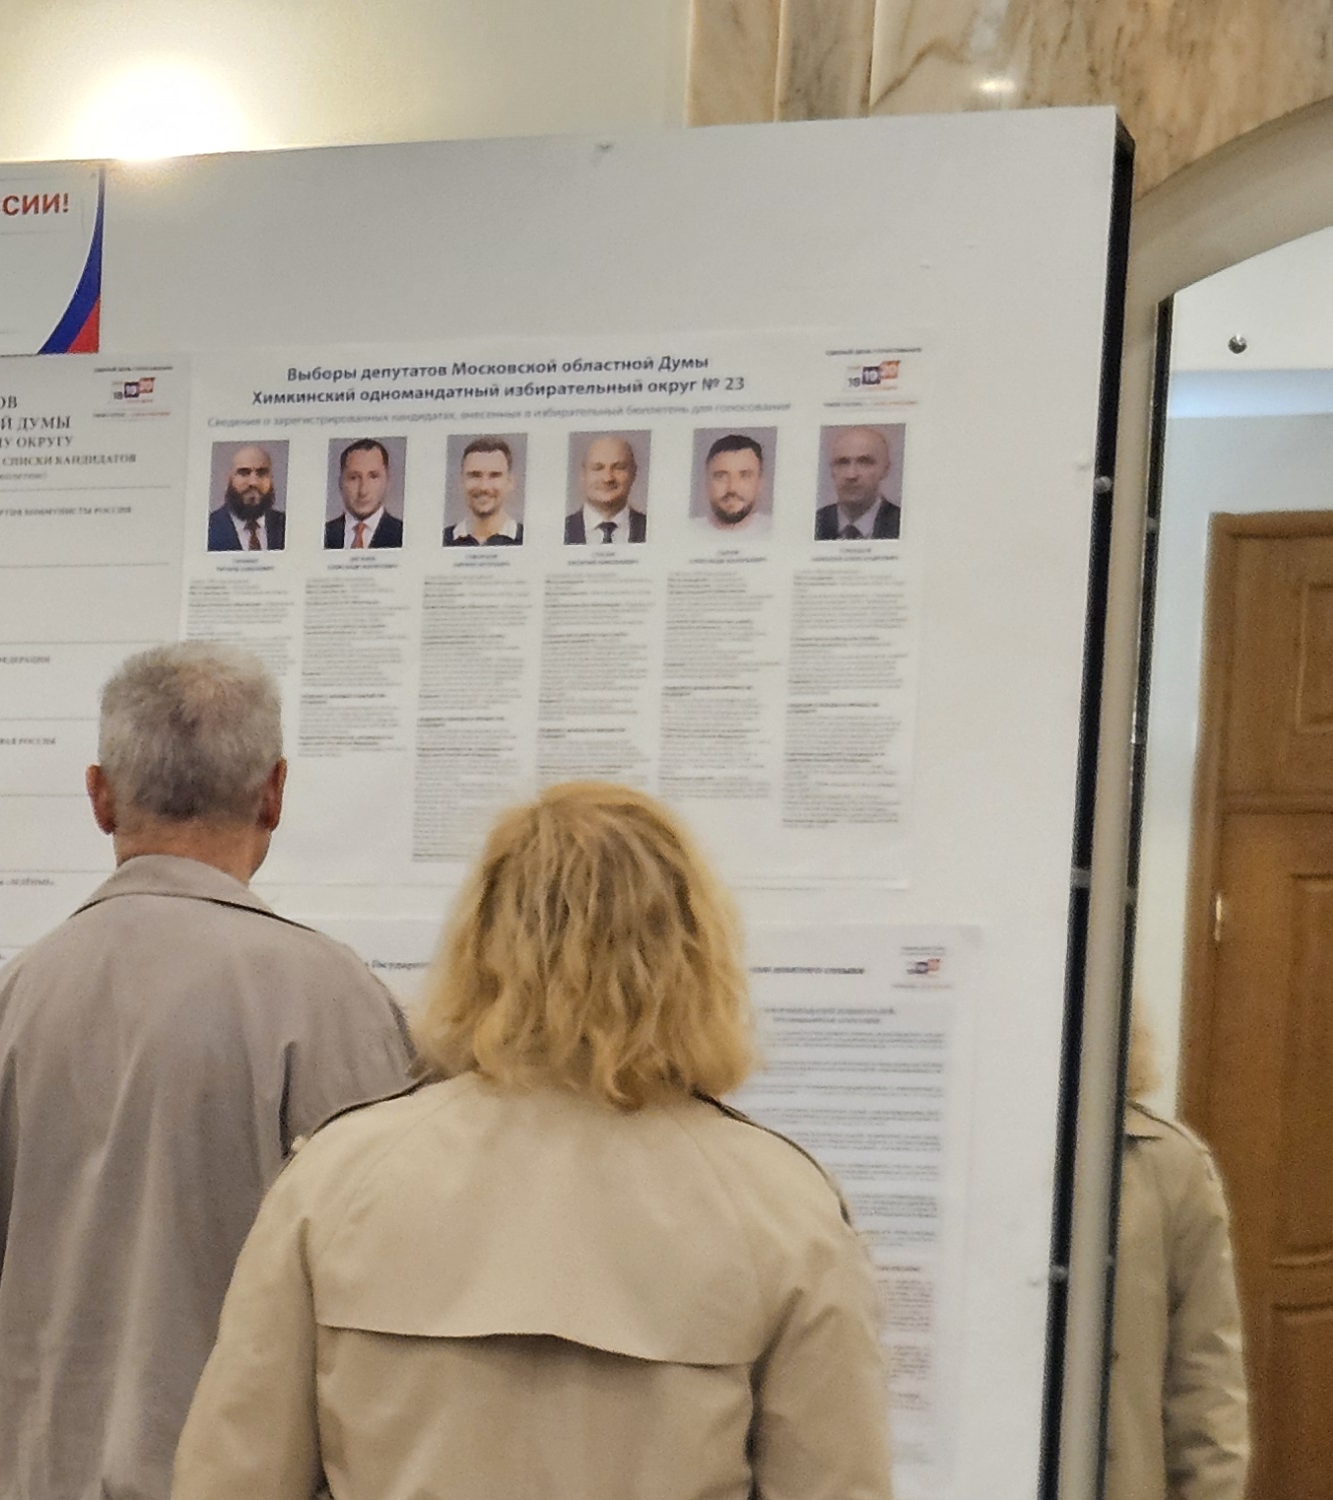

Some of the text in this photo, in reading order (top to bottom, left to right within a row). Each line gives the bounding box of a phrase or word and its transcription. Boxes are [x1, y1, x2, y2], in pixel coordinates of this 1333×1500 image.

[287, 355, 709, 383] Выборы депутатов Московской областной Думы
[252, 388, 356, 405] Химкинский
[360, 383, 500, 401] одномандатный
[504, 378, 643, 398] избирательный
[647, 379, 697, 395] округ
[724, 376, 745, 391] 23
[16, 415, 72, 431] ДУМЫ
[16, 435, 73, 448] ОКРУГУ
